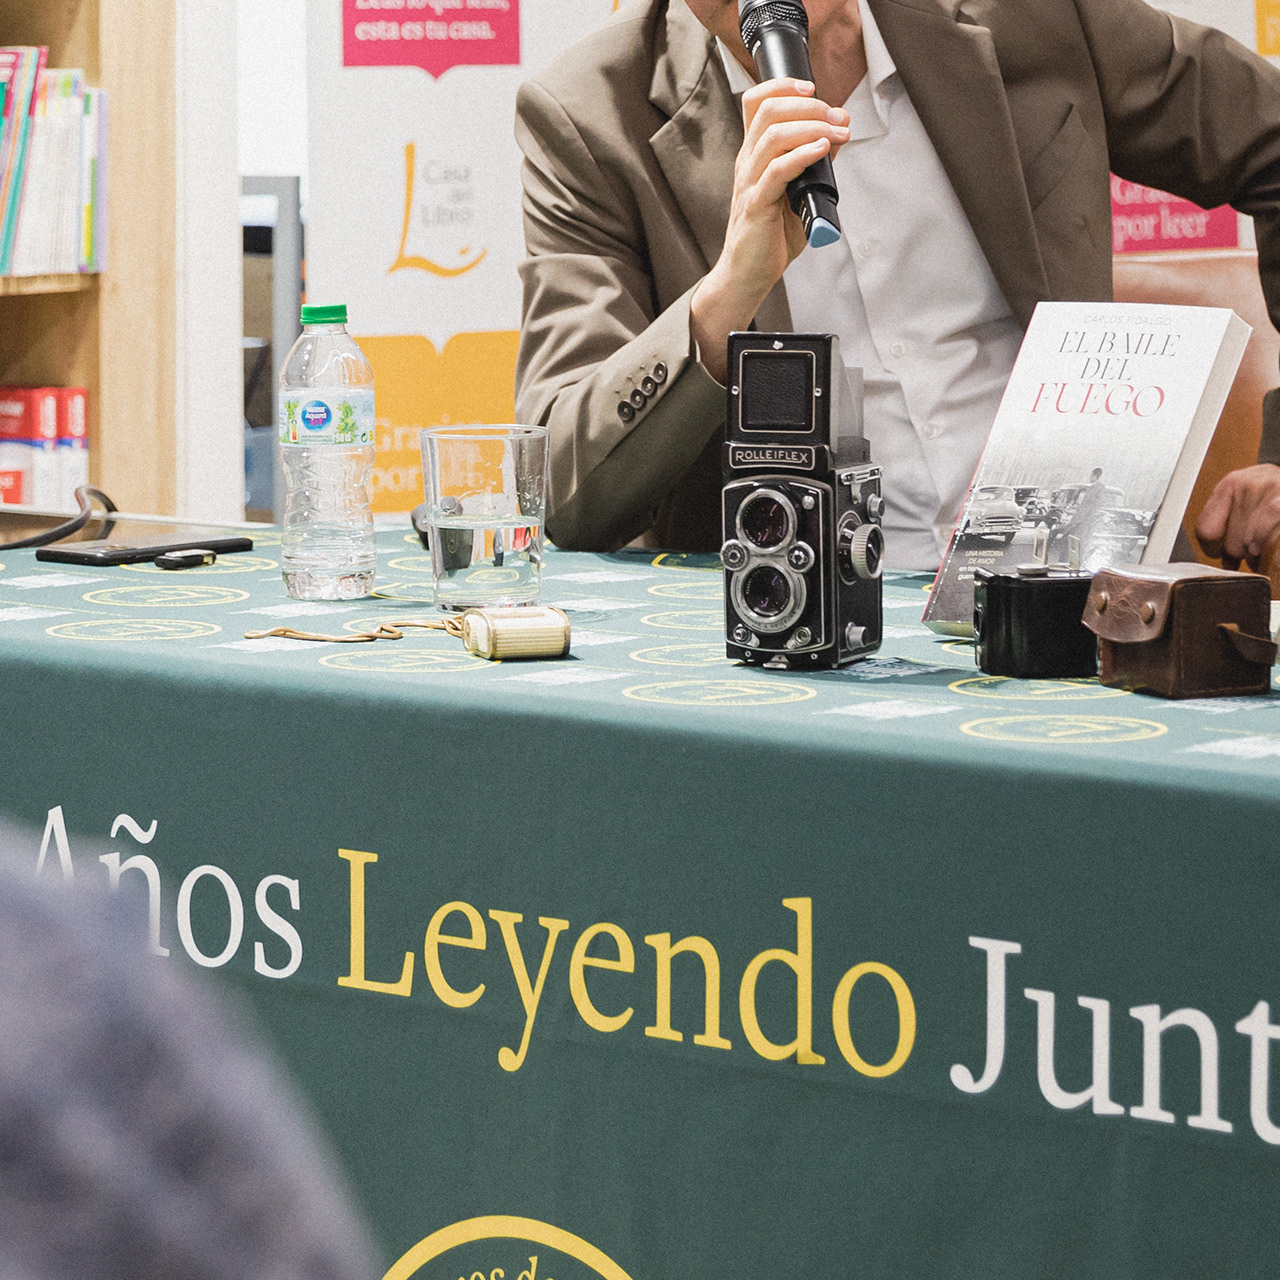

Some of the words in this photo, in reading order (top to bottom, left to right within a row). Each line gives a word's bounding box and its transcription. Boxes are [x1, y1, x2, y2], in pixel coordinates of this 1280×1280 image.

[354, 21, 401, 41] esta
[1111, 214, 1160, 251] por
[1159, 203, 1211, 239] leer
[1083, 314, 1124, 325] CARLOS
[1059, 331, 1091, 354] EL
[1097, 331, 1181, 357] BAILE
[1080, 357, 1133, 381] DEL
[1030, 382, 1166, 418] FUEGO
[735, 450, 809, 463] ROLLEIFLEX
[30, 804, 305, 980] Años
[337, 848, 917, 1078] Leyendo
